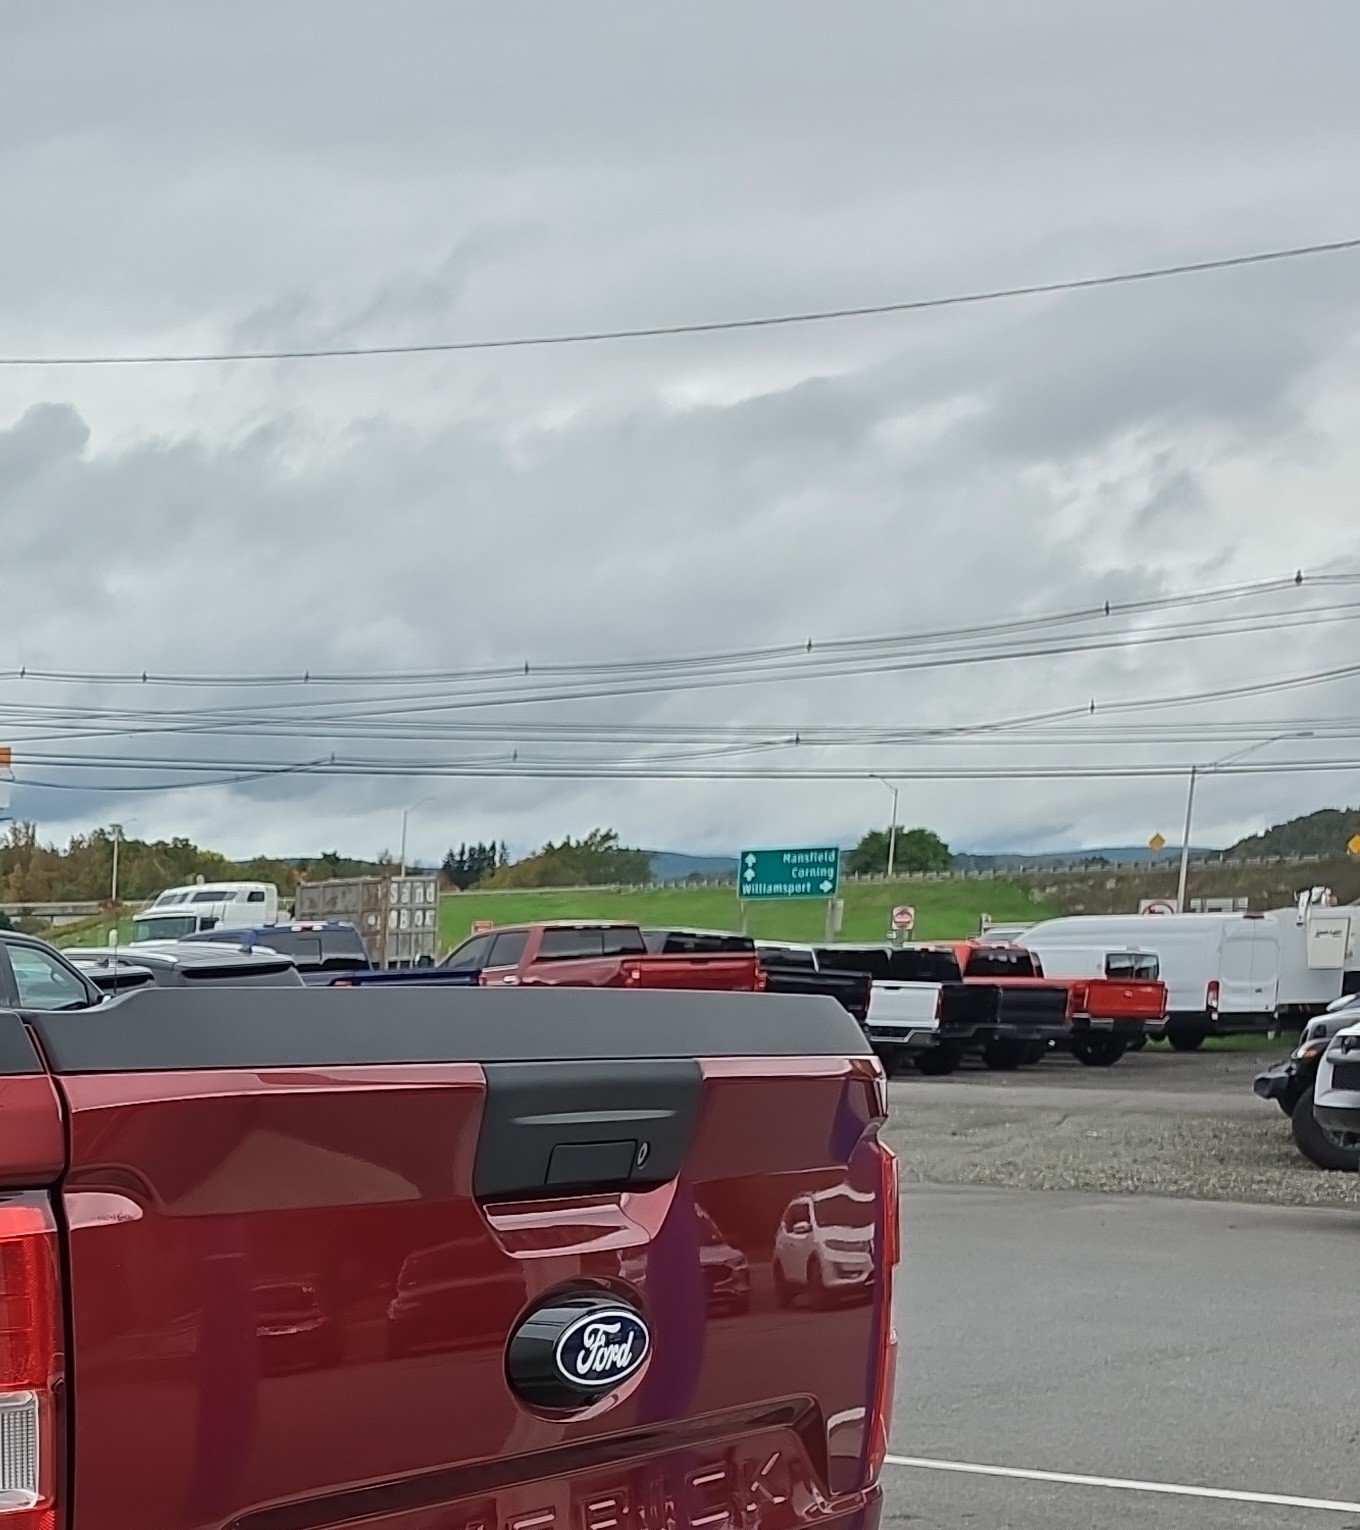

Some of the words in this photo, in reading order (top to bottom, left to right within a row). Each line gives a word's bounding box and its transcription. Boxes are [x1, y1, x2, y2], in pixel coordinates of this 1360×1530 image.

[782, 850, 836, 864] Mansfield
[791, 867, 834, 880] Corning
[742, 882, 812, 896] Williamsport
[575, 1321, 633, 1373] Ford
